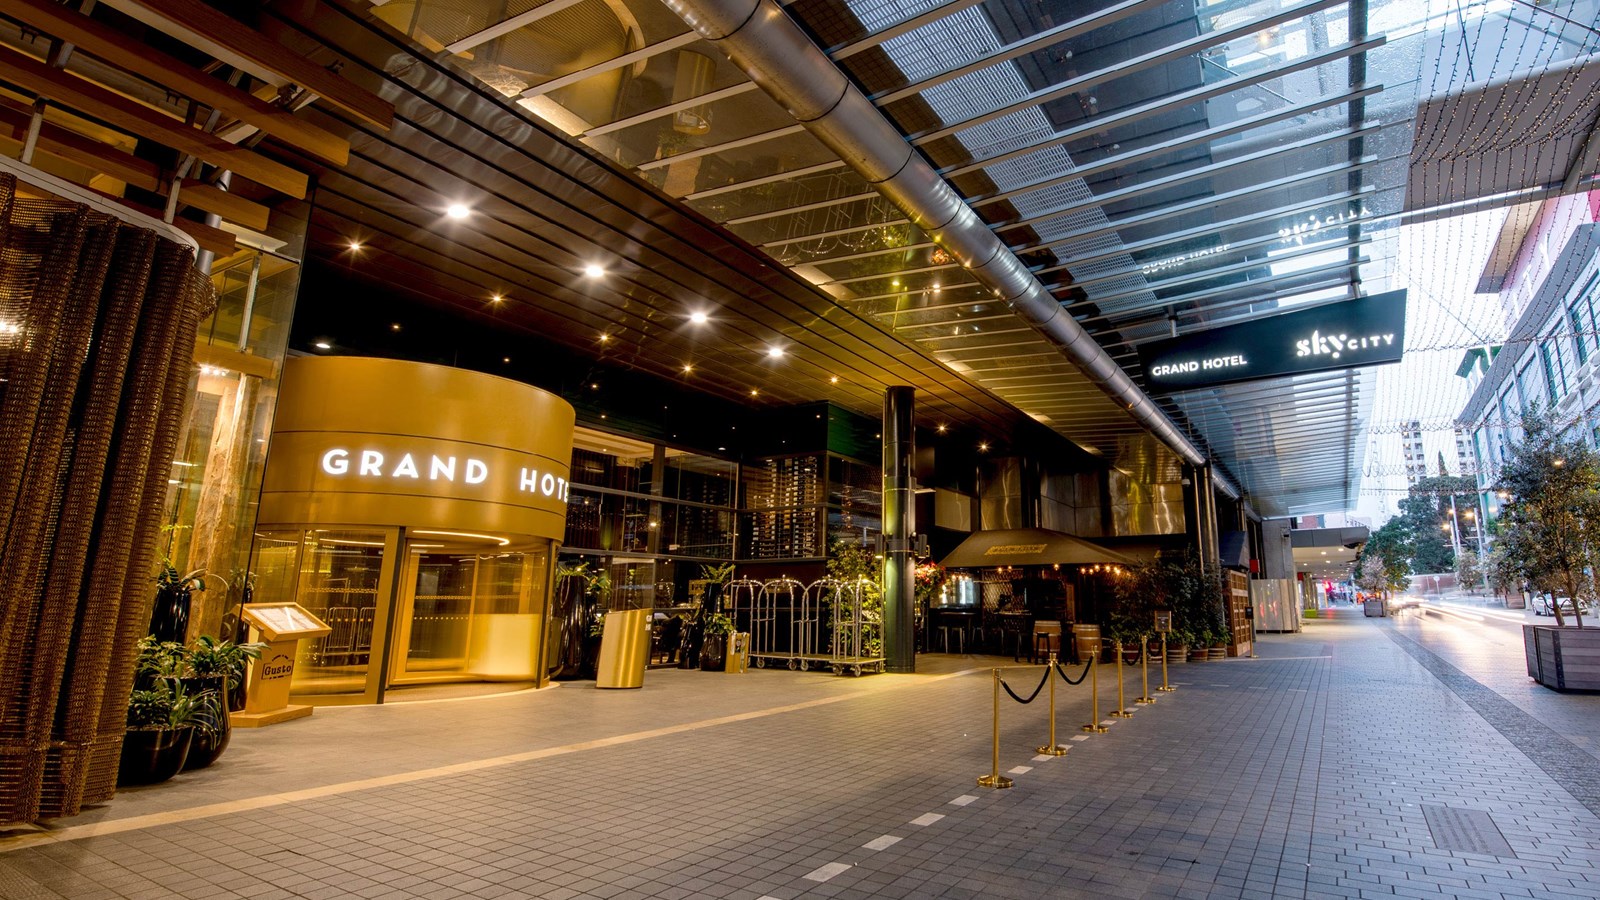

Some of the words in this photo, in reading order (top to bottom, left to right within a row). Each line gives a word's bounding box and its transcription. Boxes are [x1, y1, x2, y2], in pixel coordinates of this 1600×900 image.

[1152, 361, 1199, 376] GRAND
[1202, 354, 1248, 370] HOTEL
[322, 448, 489, 484] GRAND
[264, 665, 292, 675] Gusto
